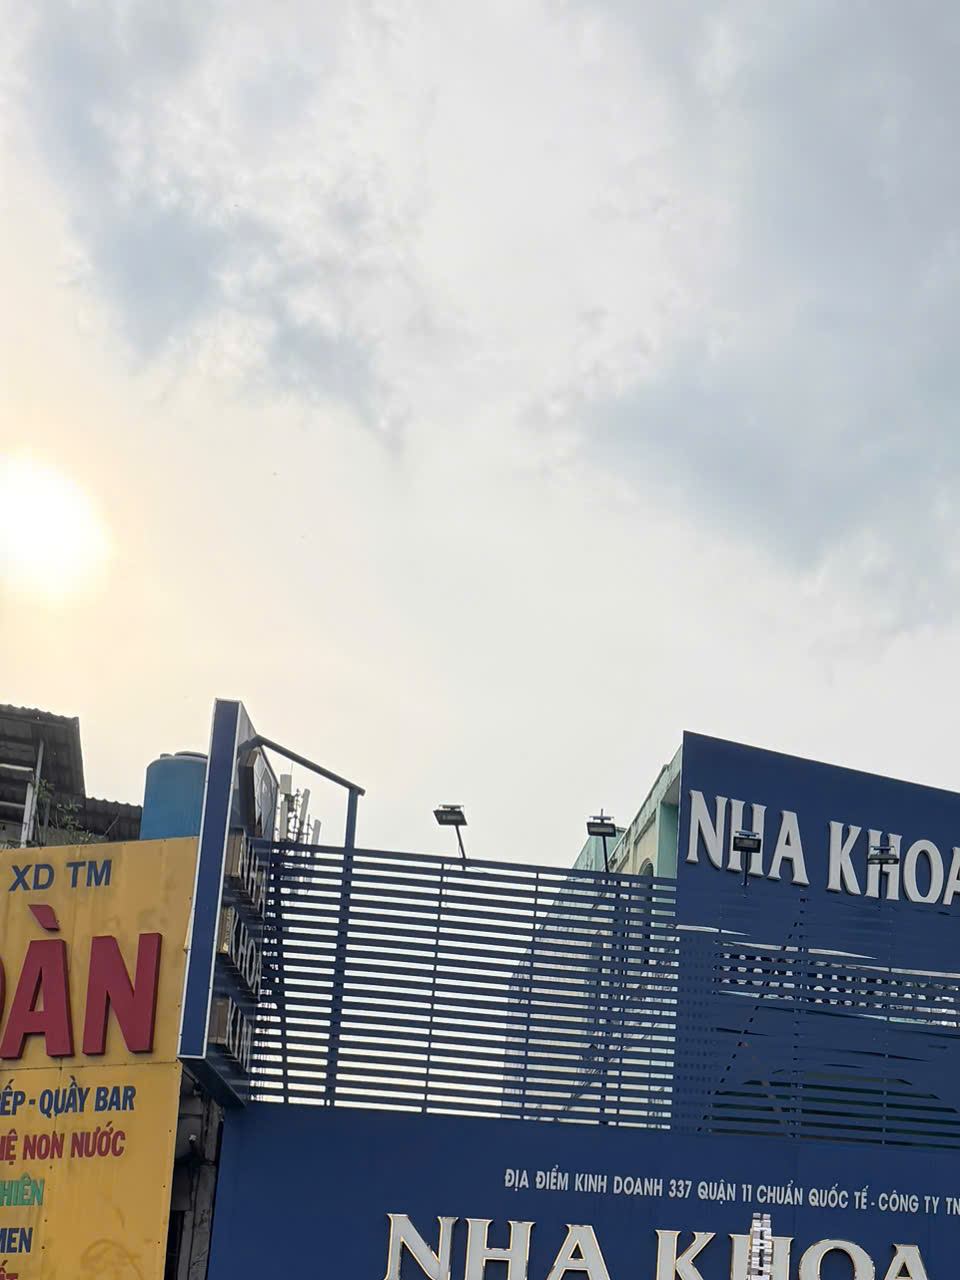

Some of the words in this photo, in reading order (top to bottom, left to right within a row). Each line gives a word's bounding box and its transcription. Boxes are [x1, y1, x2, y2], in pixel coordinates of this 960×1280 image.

[685, 789, 809, 887] NHA
[8, 863, 55, 892] XD
[66, 859, 112, 889] TM
[0, 904, 163, 1059] ÀN
[0, 1079, 26, 1116] ẾP
[39, 1077, 90, 1119] QUẦY
[94, 1085, 136, 1112] BAR
[22, 1133, 65, 1161] NON
[70, 1121, 126, 1158] NƯỚC
[504, 1168, 529, 1191] ĐỊA
[535, 1164, 569, 1191] ĐIỂM
[575, 1173, 607, 1193] KINH
[613, 1176, 663, 1197] DOANH
[668, 1179, 692, 1199] 337
[697, 1178, 736, 1205] QUẬN
[742, 1184, 752, 1202] 11
[756, 1179, 803, 1206] CHUẨN
[808, 1183, 849, 1209] QUỐC
[854, 1184, 868, 1210] TẾ
[878, 1190, 919, 1213] CÔNG
[924, 1196, 940, 1215] TY
